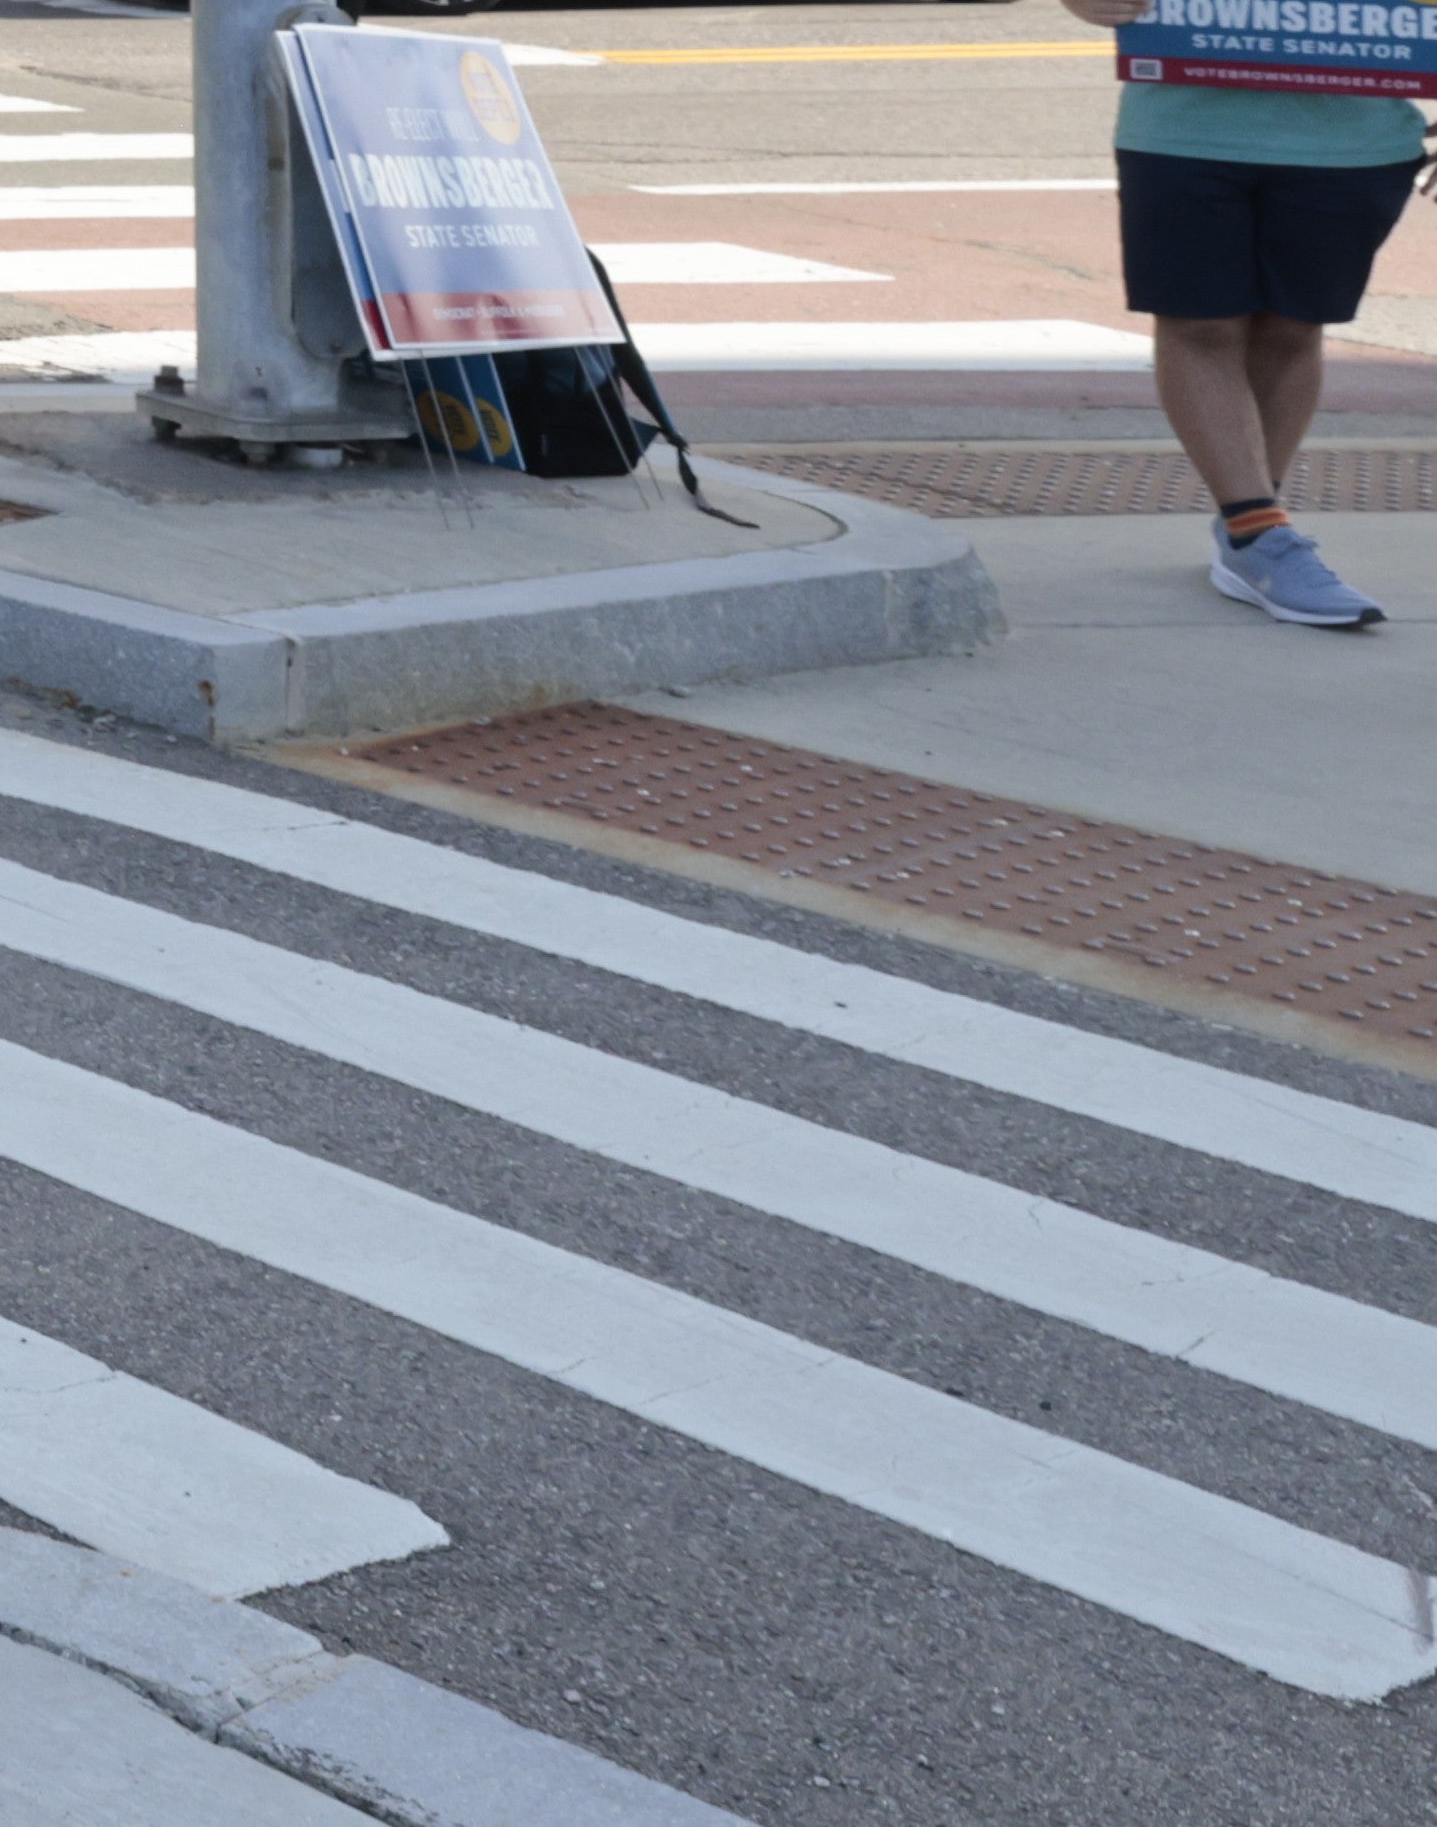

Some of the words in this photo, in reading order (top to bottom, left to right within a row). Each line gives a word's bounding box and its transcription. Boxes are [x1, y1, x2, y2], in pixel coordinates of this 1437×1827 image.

[1192, 34, 1274, 52] STATE
[1283, 38, 1412, 60] SENATOR
[348, 153, 555, 209] BROWNSBERGER
[405, 225, 460, 248] STATE
